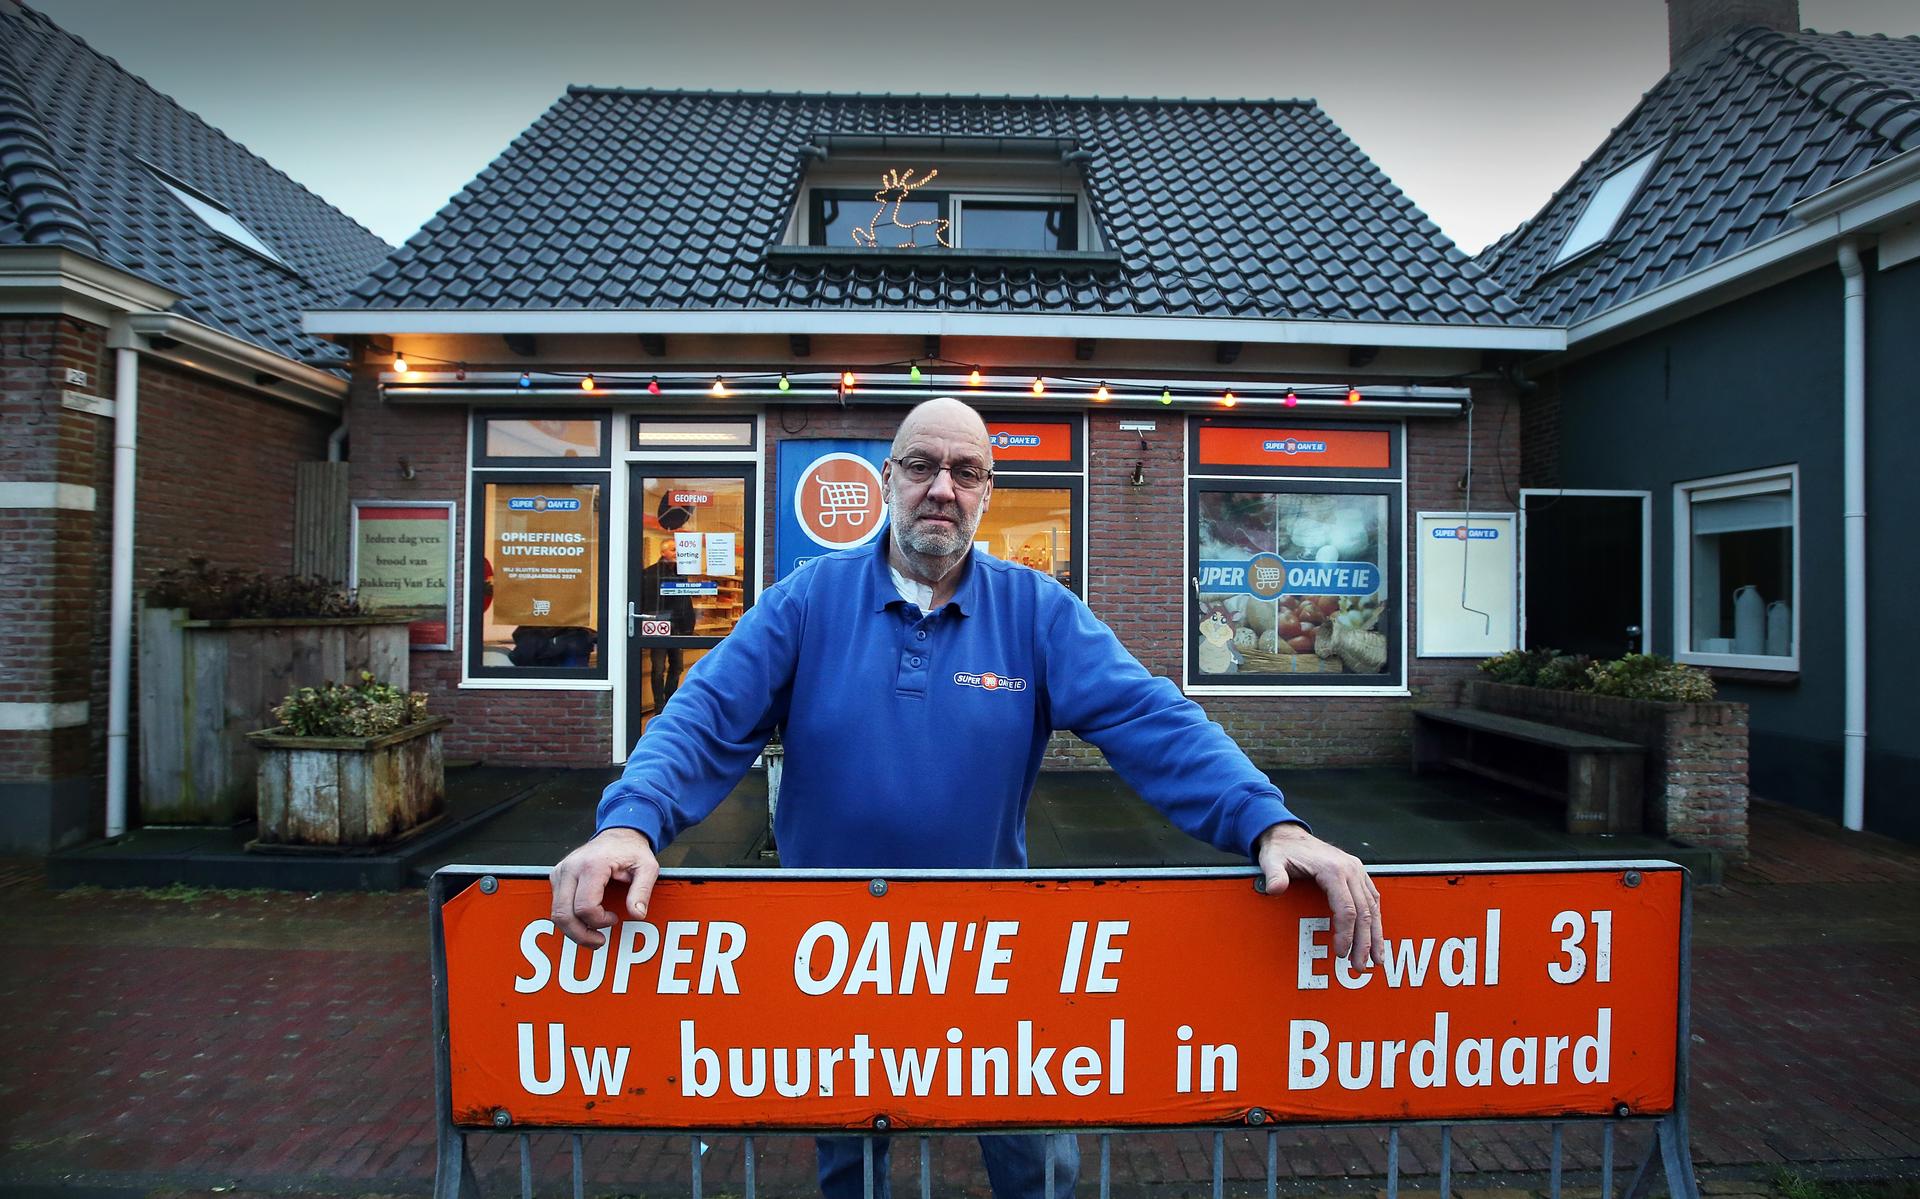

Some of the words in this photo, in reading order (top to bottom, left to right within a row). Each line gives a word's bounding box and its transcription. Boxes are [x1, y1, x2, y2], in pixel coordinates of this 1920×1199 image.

[511, 500, 533, 508] SUPER
[674, 494, 708, 503] GEOPEND
[365, 533, 397, 544] Iedere
[398, 533, 418, 547] dag
[419, 536, 440, 544] vers
[501, 532, 586, 543] OPHEFFINGS-
[678, 540, 697, 548] 40%
[502, 546, 584, 556] UITVERKOOP
[677, 551, 699, 559] korting
[376, 555, 406, 566] brood
[1198, 567, 1246, 587] UPER
[1351, 569, 1370, 588] IE
[360, 578, 401, 590] Bakkerij
[403, 578, 423, 588] Van
[426, 578, 446, 588] Eck
[957, 675, 981, 685] SUPER
[515, 919, 746, 995] SUPER
[795, 920, 1019, 996] OAN'E
[1060, 921, 1129, 994] IE
[1298, 908, 1501, 990] Eewal
[1548, 910, 1612, 984] 31
[518, 1024, 630, 1096] Uw
[681, 1019, 1124, 1098] buurtwinkel
[1177, 1026, 1238, 1093] in
[1289, 1008, 1612, 1090] Burdaard
